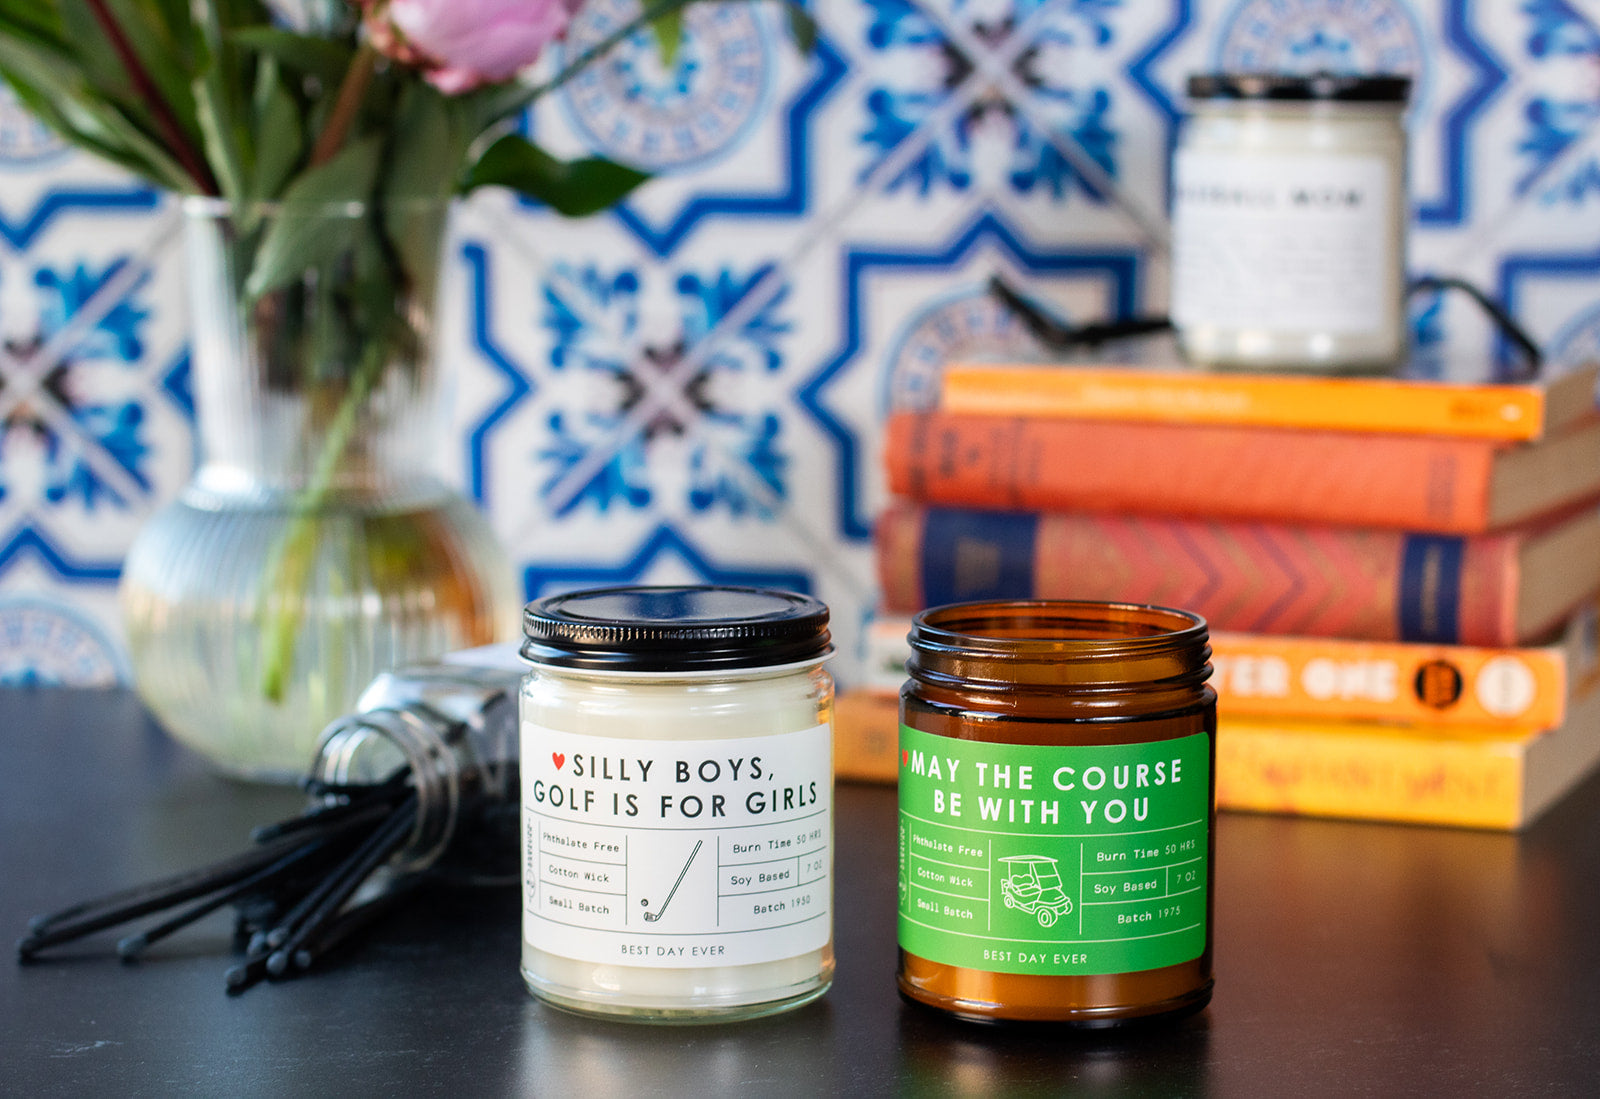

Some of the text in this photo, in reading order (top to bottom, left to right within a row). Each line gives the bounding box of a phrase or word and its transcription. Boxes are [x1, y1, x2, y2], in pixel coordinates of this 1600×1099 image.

[572, 754, 775, 783] SILLY BOYS,
[911, 749, 1182, 791] MAY THE COURSE
[533, 780, 818, 818] GOLF IS FOR GIRLS
[934, 789, 1149, 825] BE WITH YOU
[542, 832, 620, 853] Phthalate Free
[733, 829, 822, 854] Burn Time 50 HRS
[913, 834, 983, 858] Phthalate Free
[1097, 839, 1196, 862] Burn Time 50 HRS
[548, 864, 610, 883] Cotton Wick
[806, 859, 823, 872] 7 OZ
[731, 870, 790, 887] Soy Based
[917, 867, 974, 888] Cotton Wick
[1094, 879, 1157, 895] Soy Based
[1176, 870, 1196, 884] 7 OZ
[548, 896, 610, 915] Small Batch
[753, 894, 812, 915] Batch 1950
[917, 898, 974, 920] Small Batch
[1117, 906, 1181, 925] Batch 1975
[620, 944, 726, 956] BEST DAY EVER
[983, 949, 1088, 964] BEST DAY EVER
